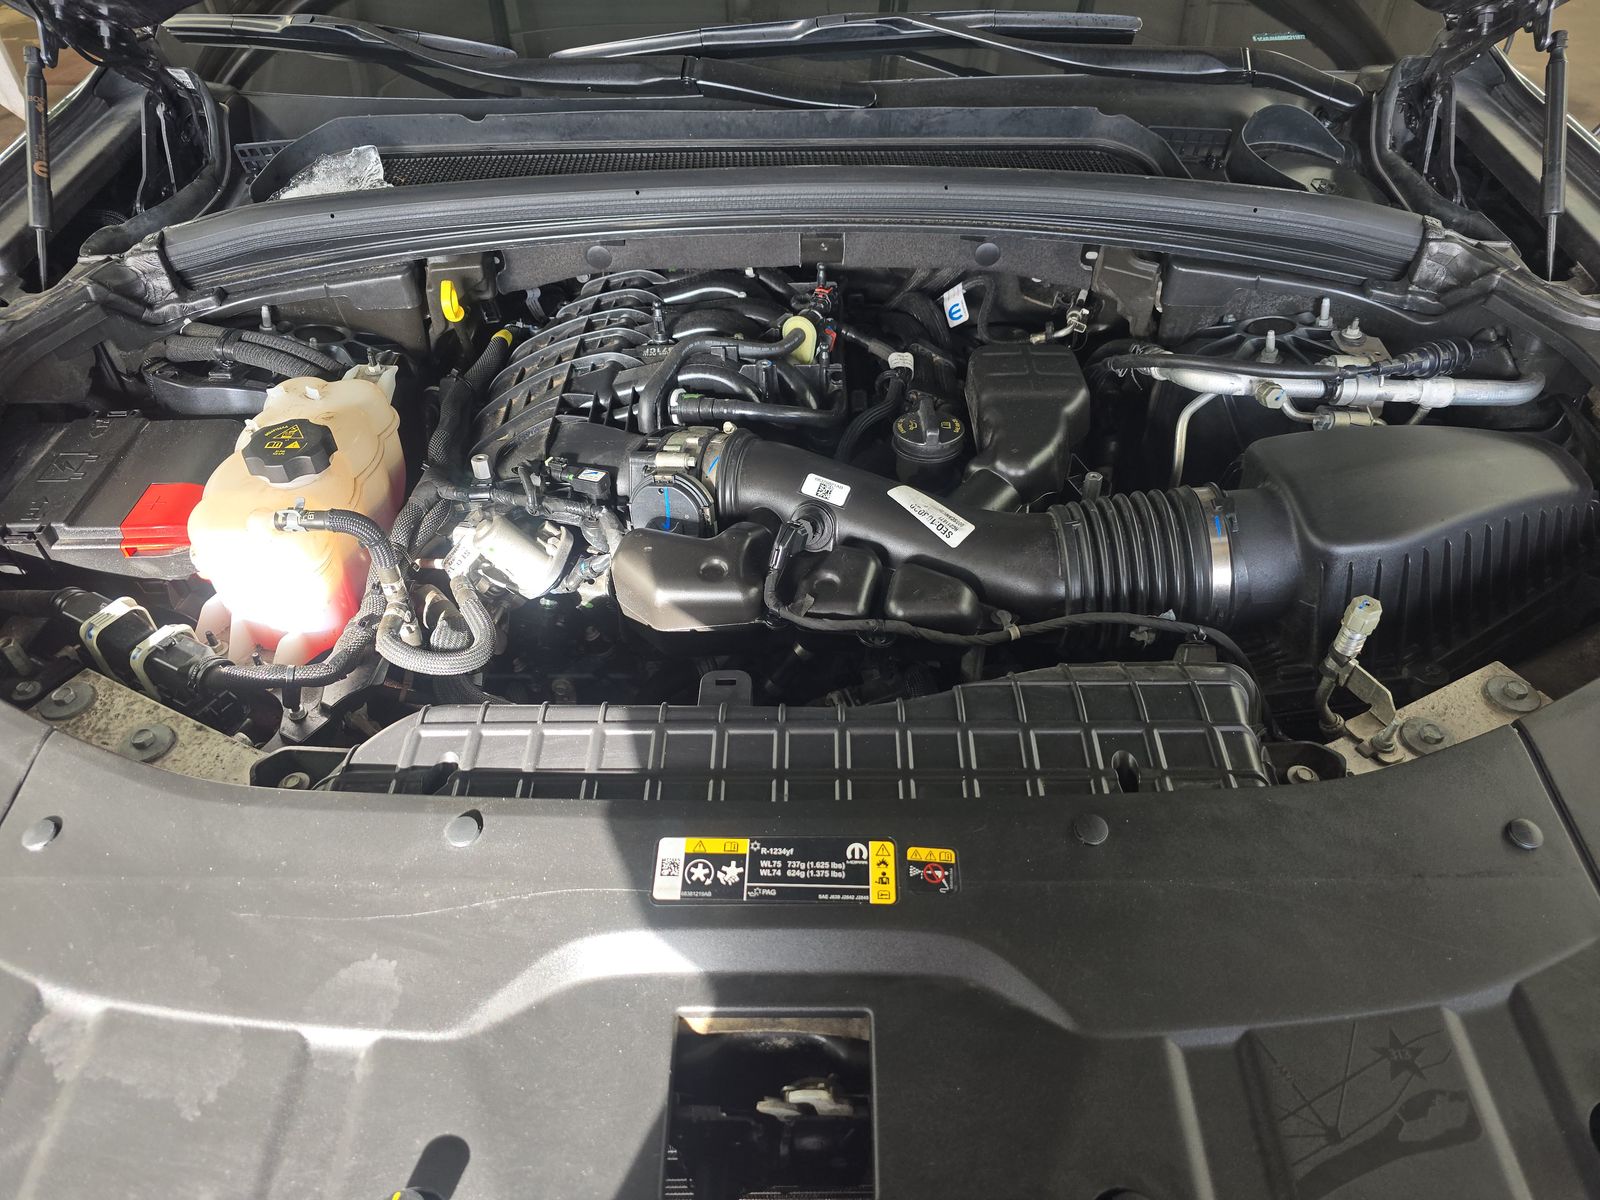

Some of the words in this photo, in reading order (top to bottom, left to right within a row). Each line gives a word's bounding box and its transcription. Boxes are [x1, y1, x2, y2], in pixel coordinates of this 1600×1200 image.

[760, 847, 794, 857] R-1234yf
[760, 860, 782, 868] WL75
[786, 861, 806, 870] 737g
[806, 861, 830, 870] (1.625
[830, 862, 846, 870] lbs)
[760, 869, 782, 877] WL74
[786, 869, 806, 878] 624g
[806, 870, 830, 878] (1.375
[830, 870, 846, 879] lbs)
